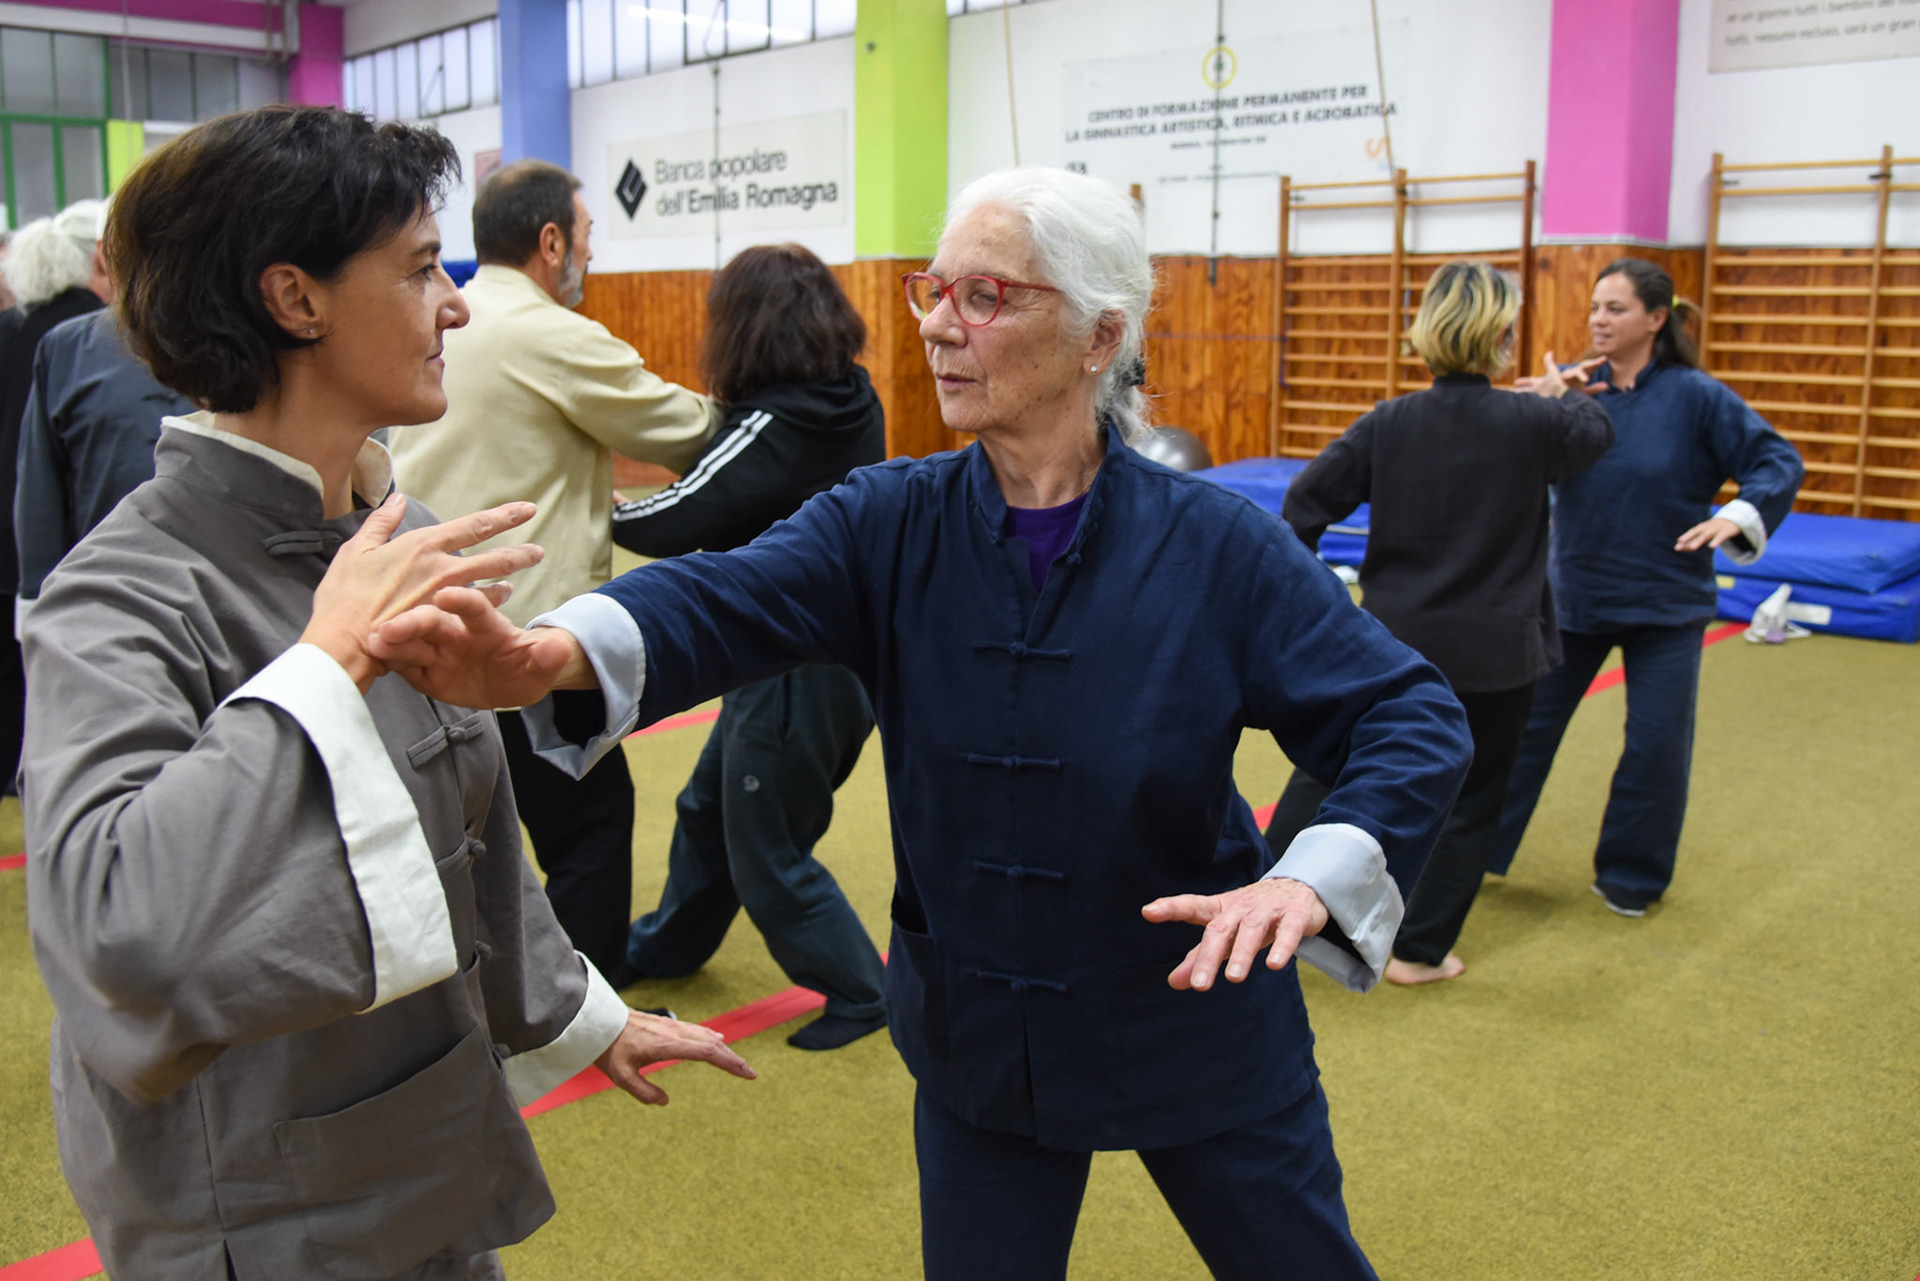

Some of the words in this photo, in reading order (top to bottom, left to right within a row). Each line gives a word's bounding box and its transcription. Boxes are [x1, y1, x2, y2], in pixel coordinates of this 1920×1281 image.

[1065, 130, 1079, 143] LA
[1083, 123, 1156, 141] GINNASTICA
[1233, 111, 1288, 128] RITMICA
[1292, 111, 1300, 124] E
[1304, 102, 1397, 123] ACROBATICA
[1088, 107, 1133, 123] CENTRO
[1137, 105, 1149, 119] DI
[1152, 97, 1239, 117] FORMAZIONE
[1243, 87, 1337, 109] PERMANENTE
[1341, 85, 1368, 99] PER
[655, 158, 704, 184] Banca
[709, 147, 788, 183] popolare
[656, 184, 740, 216] dell'Emilia
[746, 181, 838, 211] Romagna
